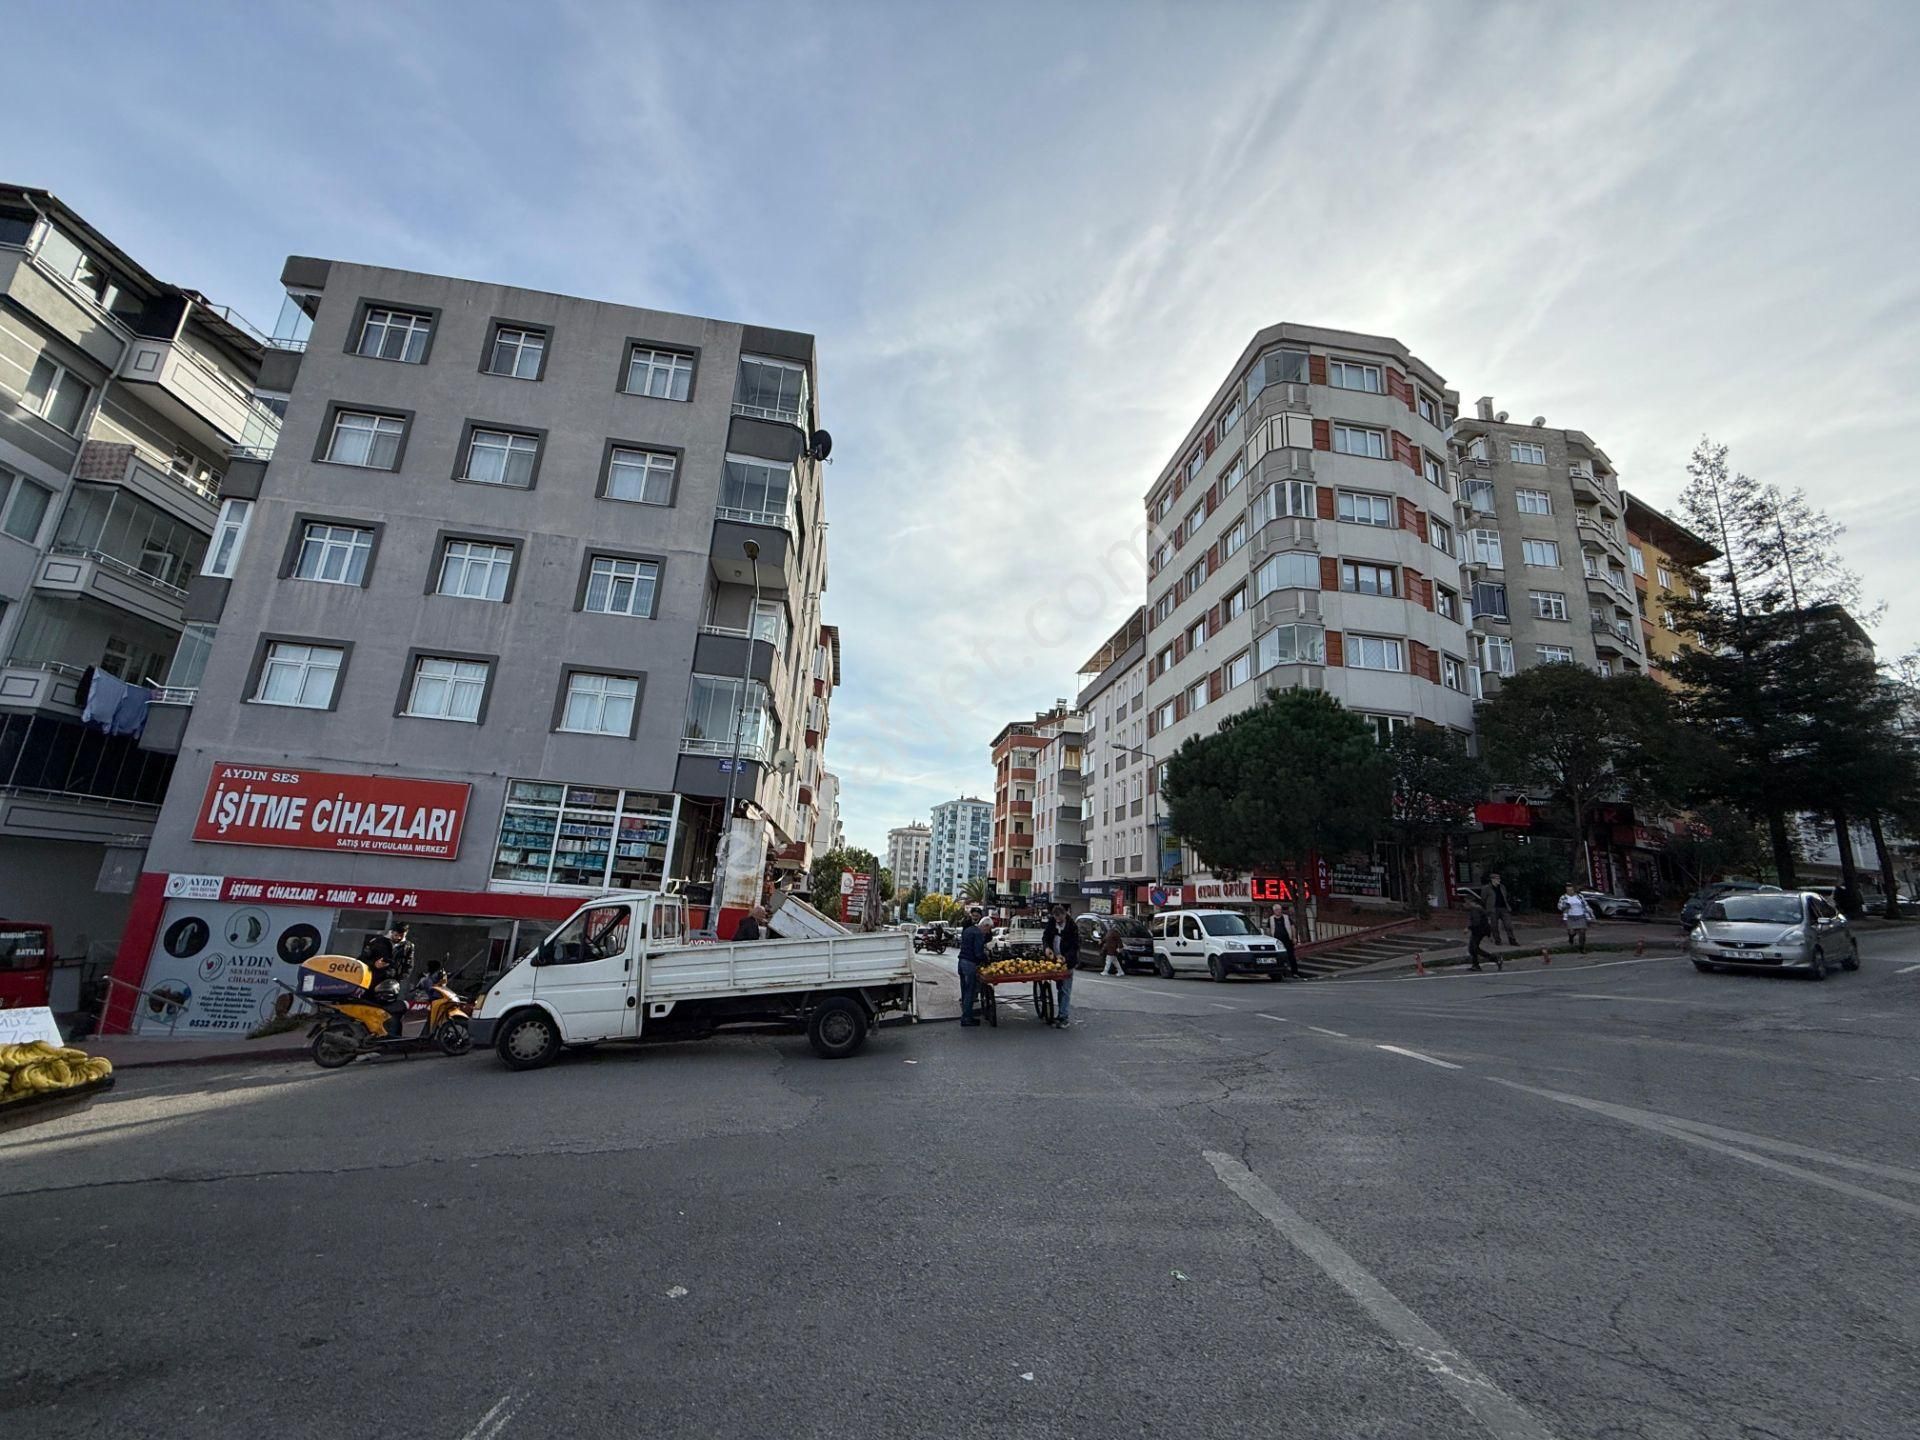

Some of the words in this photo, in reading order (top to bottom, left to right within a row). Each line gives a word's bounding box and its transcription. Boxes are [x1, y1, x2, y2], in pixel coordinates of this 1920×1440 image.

[221, 768, 267, 781] AYDIN
[271, 772, 300, 784] SES
[208, 782, 308, 834] İŞİTME
[311, 792, 456, 842] CİHAZLARI
[336, 838, 359, 848] SATIŞ
[360, 841, 371, 849] VE
[372, 841, 413, 852] UYGULAMA
[414, 843, 448, 853] MERKEZİ
[229, 881, 262, 899] İŞİTME
[266, 883, 317, 901] CİHAZLARI
[326, 888, 356, 903] TAMİR
[366, 892, 395, 906] KALIP
[402, 894, 418, 907] PİL
[227, 955, 274, 968] AYDIN
[328, 962, 360, 974] getir
